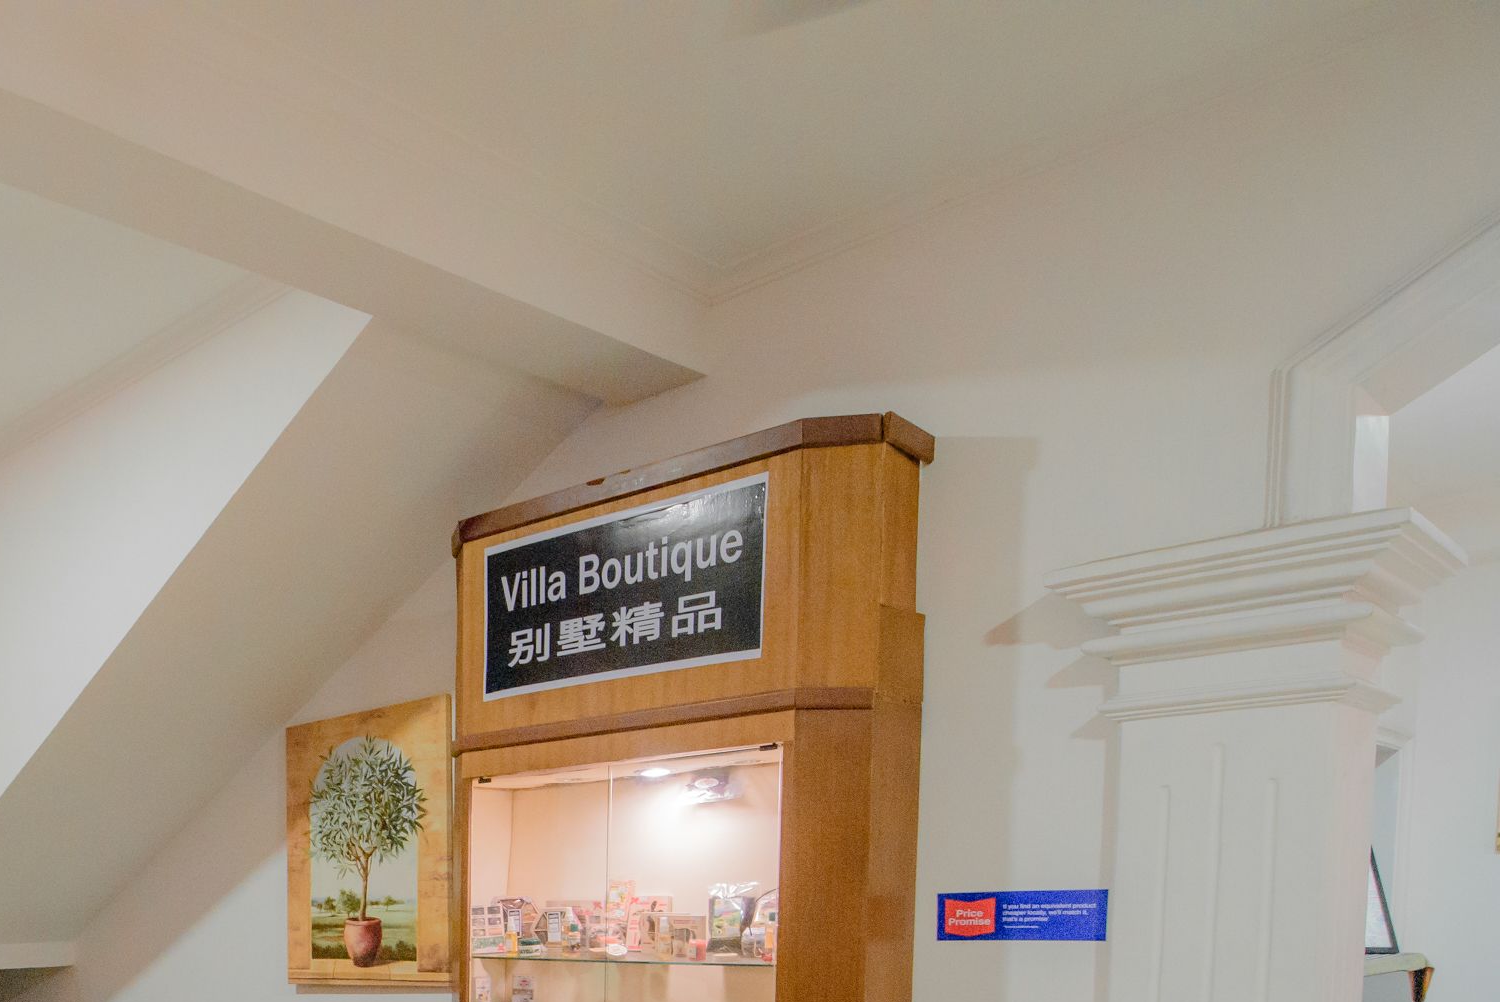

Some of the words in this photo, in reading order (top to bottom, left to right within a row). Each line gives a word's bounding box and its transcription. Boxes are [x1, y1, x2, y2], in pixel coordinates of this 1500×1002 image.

[501, 565, 567, 612] Villa
[578, 529, 744, 595] Boutique
[507, 590, 723, 668] 别墅精品
[948, 917, 991, 926] Promise
[956, 909, 984, 918] Price
